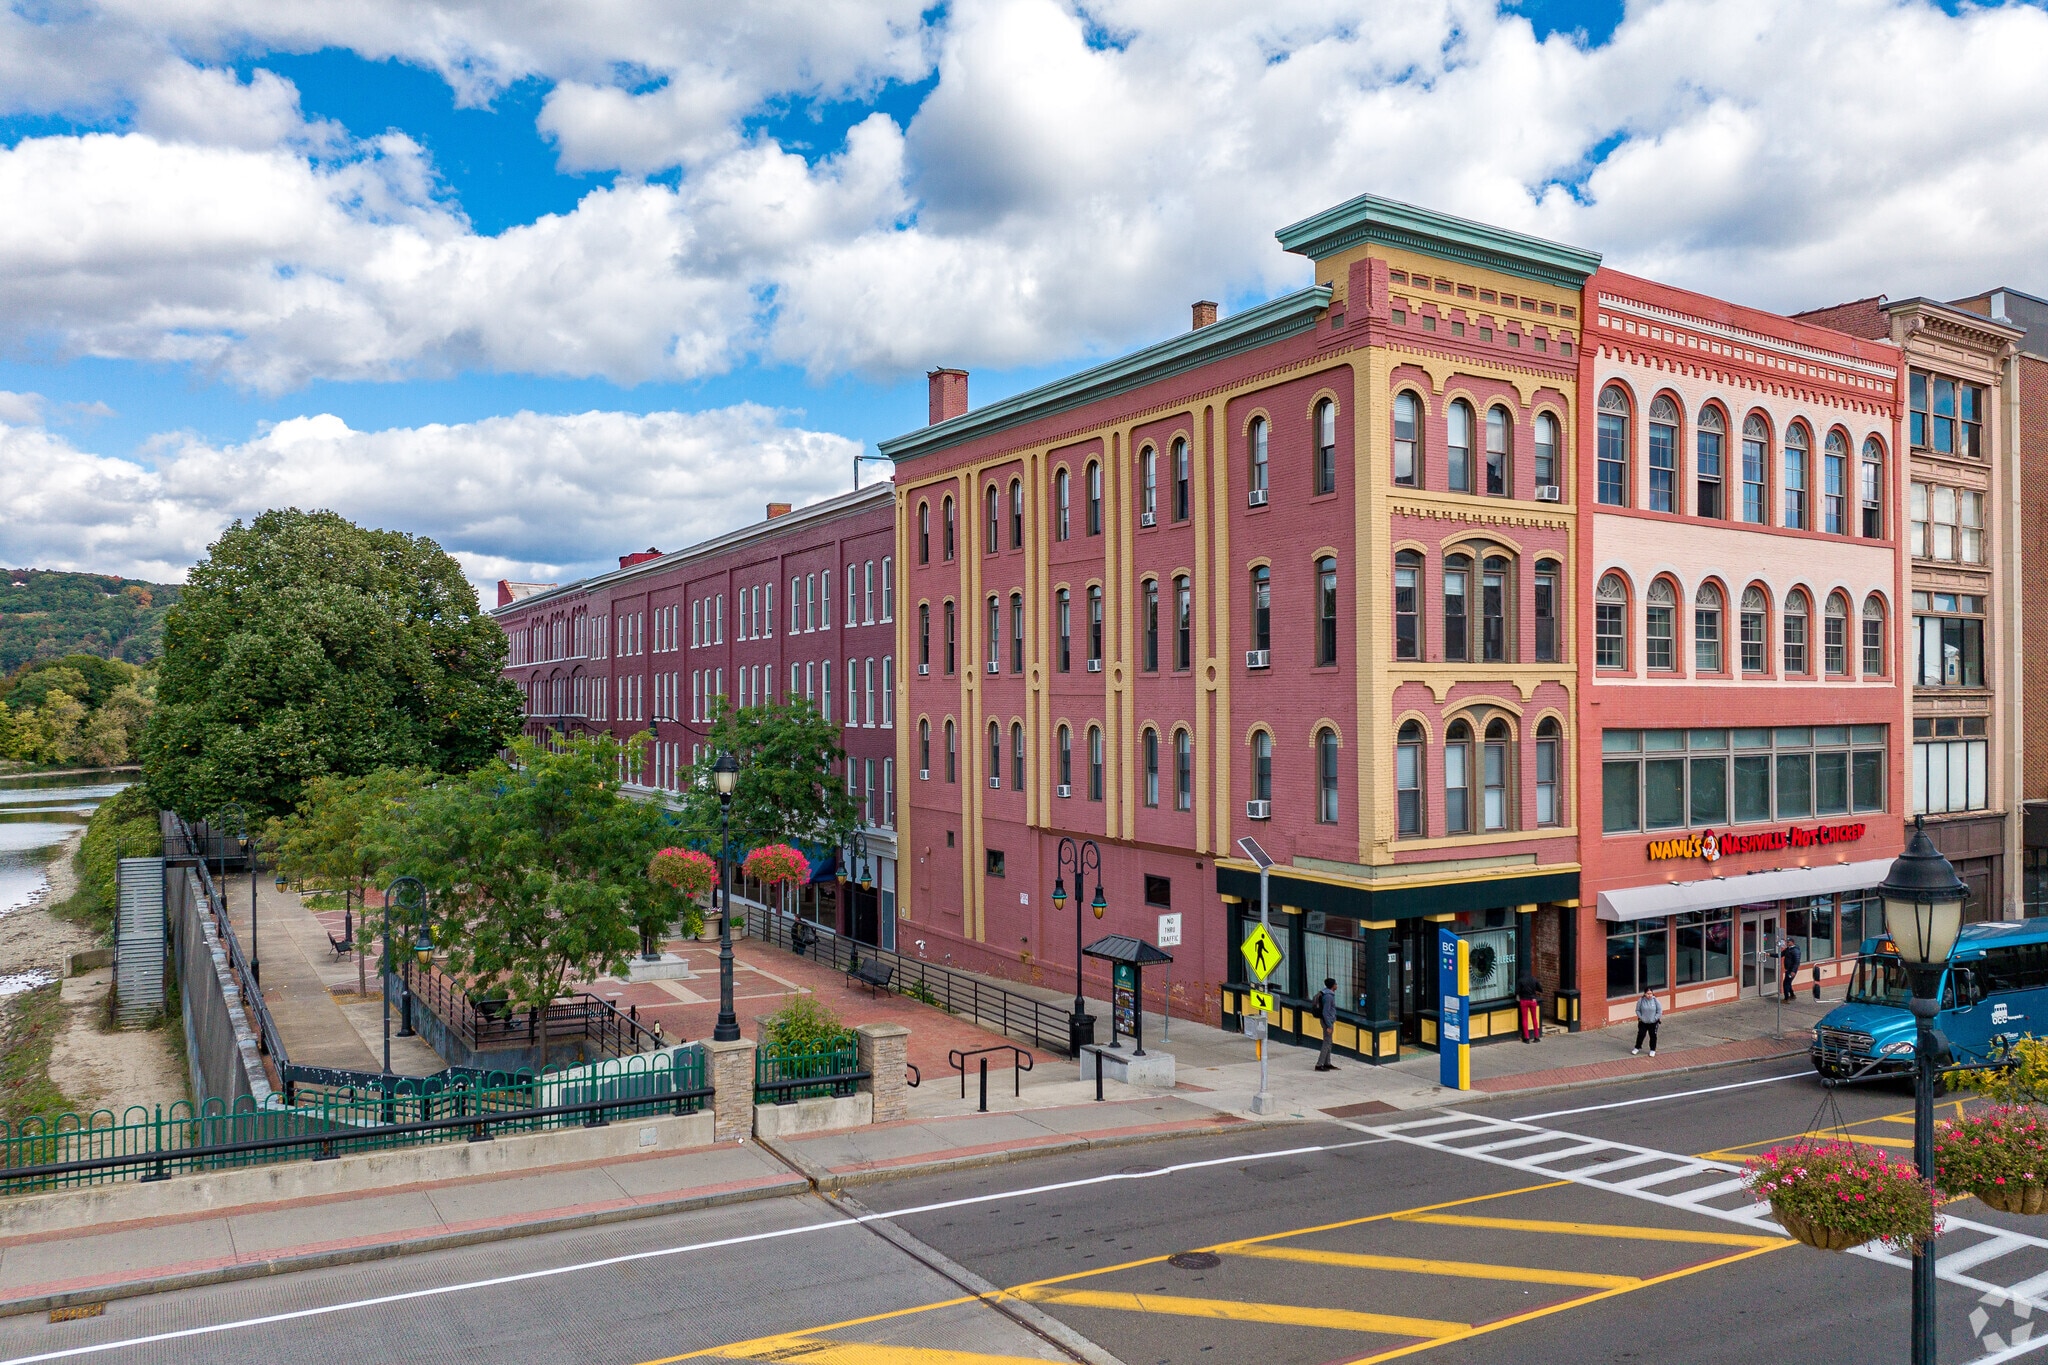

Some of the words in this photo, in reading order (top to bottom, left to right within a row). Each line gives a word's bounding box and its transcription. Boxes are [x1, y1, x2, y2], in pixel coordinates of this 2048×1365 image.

[1648, 833, 1702, 861] NANU'S
[1720, 832, 1788, 857] NASHVILLE
[1790, 827, 1819, 848] HOT
[1819, 823, 1866, 844] CHICKEN
[1161, 935, 1178, 943] TRAFFIC
[1442, 942, 1454, 952] BC
[1992, 1016, 2008, 1025] OCC
